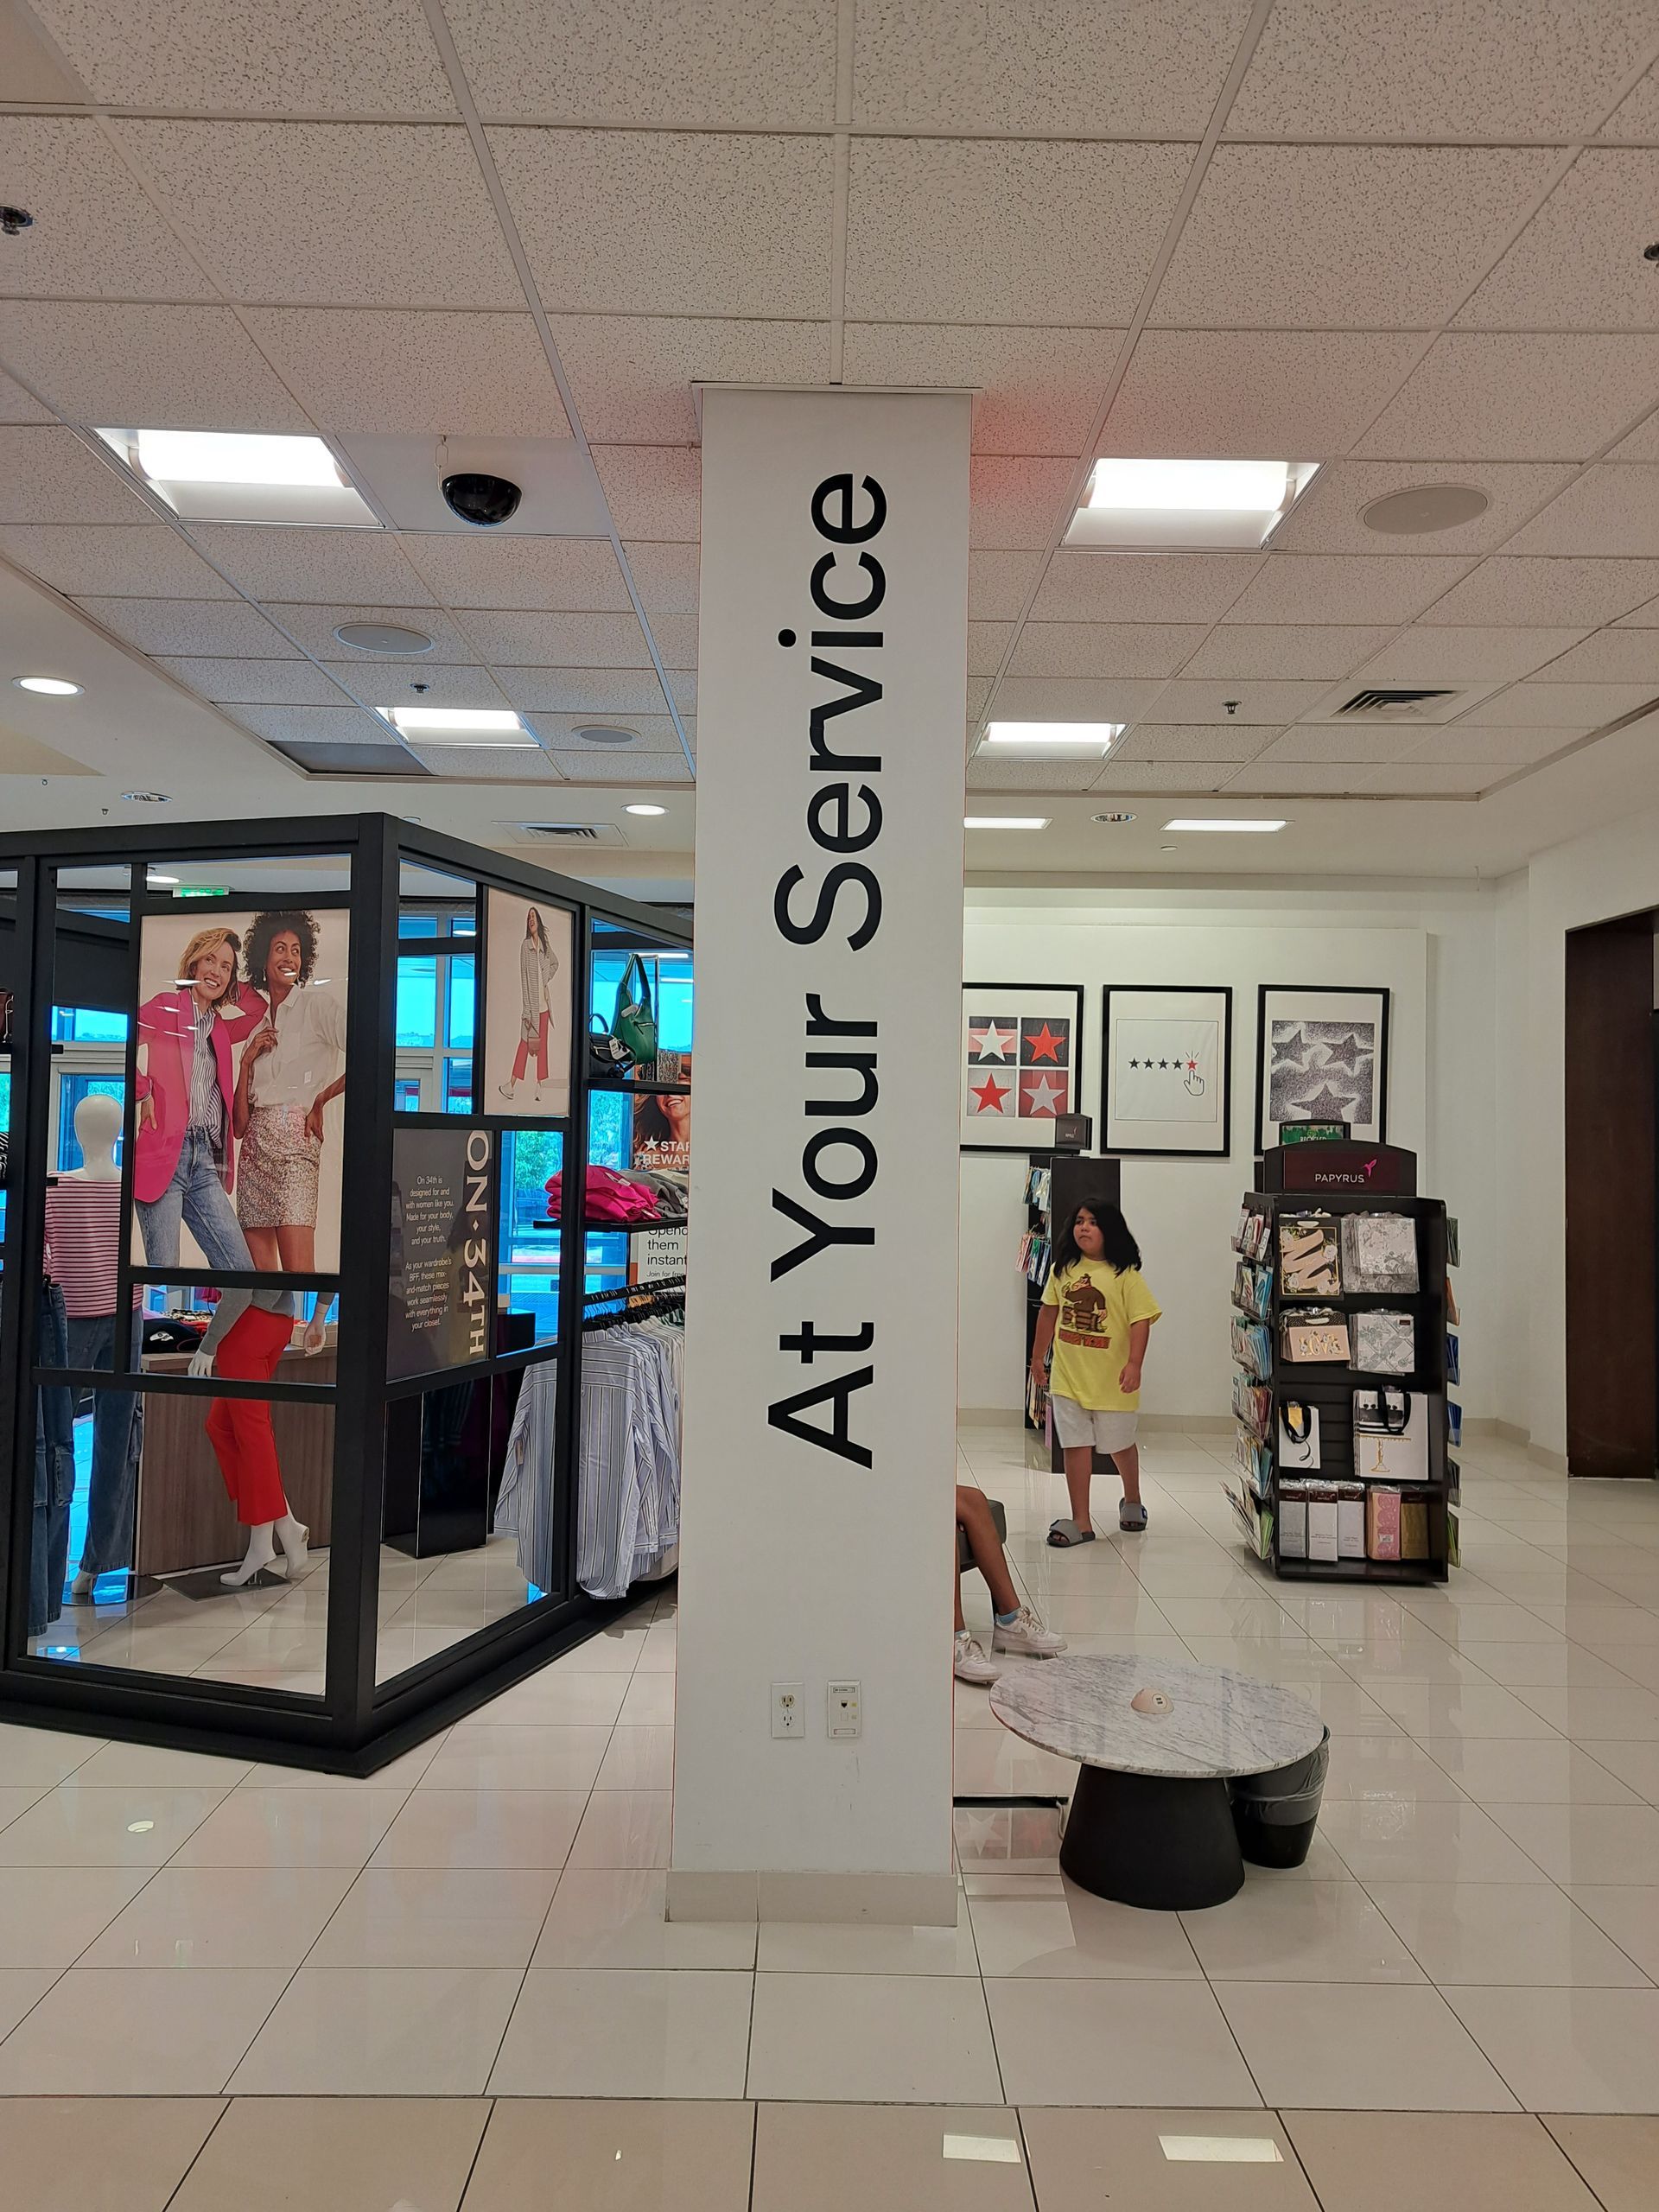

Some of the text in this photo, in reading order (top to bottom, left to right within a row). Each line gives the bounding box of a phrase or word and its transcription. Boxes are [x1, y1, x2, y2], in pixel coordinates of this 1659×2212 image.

[767, 473, 887, 1471] At Your Service
[416, 1176, 425, 1185] On
[1314, 1173, 1364, 1184] PAPYRUS
[410, 1188, 432, 1198] designed
[440, 1187, 450, 1196] and
[405, 1201, 416, 1210] with
[434, 1199, 443, 1208] like
[443, 1200, 454, 1209] you.
[406, 1212, 419, 1221] Made
[439, 1211, 454, 1219] body,
[416, 1223, 442, 1235] your style,
[411, 1234, 447, 1246] and your truth.
[463, 1130, 490, 1355] ON 34TH
[647, 1239, 679, 1250] them
[405, 1256, 452, 1271] As your wardrobe's
[647, 1254, 688, 1265] instant
[406, 1281, 450, 1294] and-match pieces
[406, 1293, 448, 1306] work seamlessly
[404, 1304, 449, 1319] with everything in
[411, 1318, 442, 1332] your closet.
